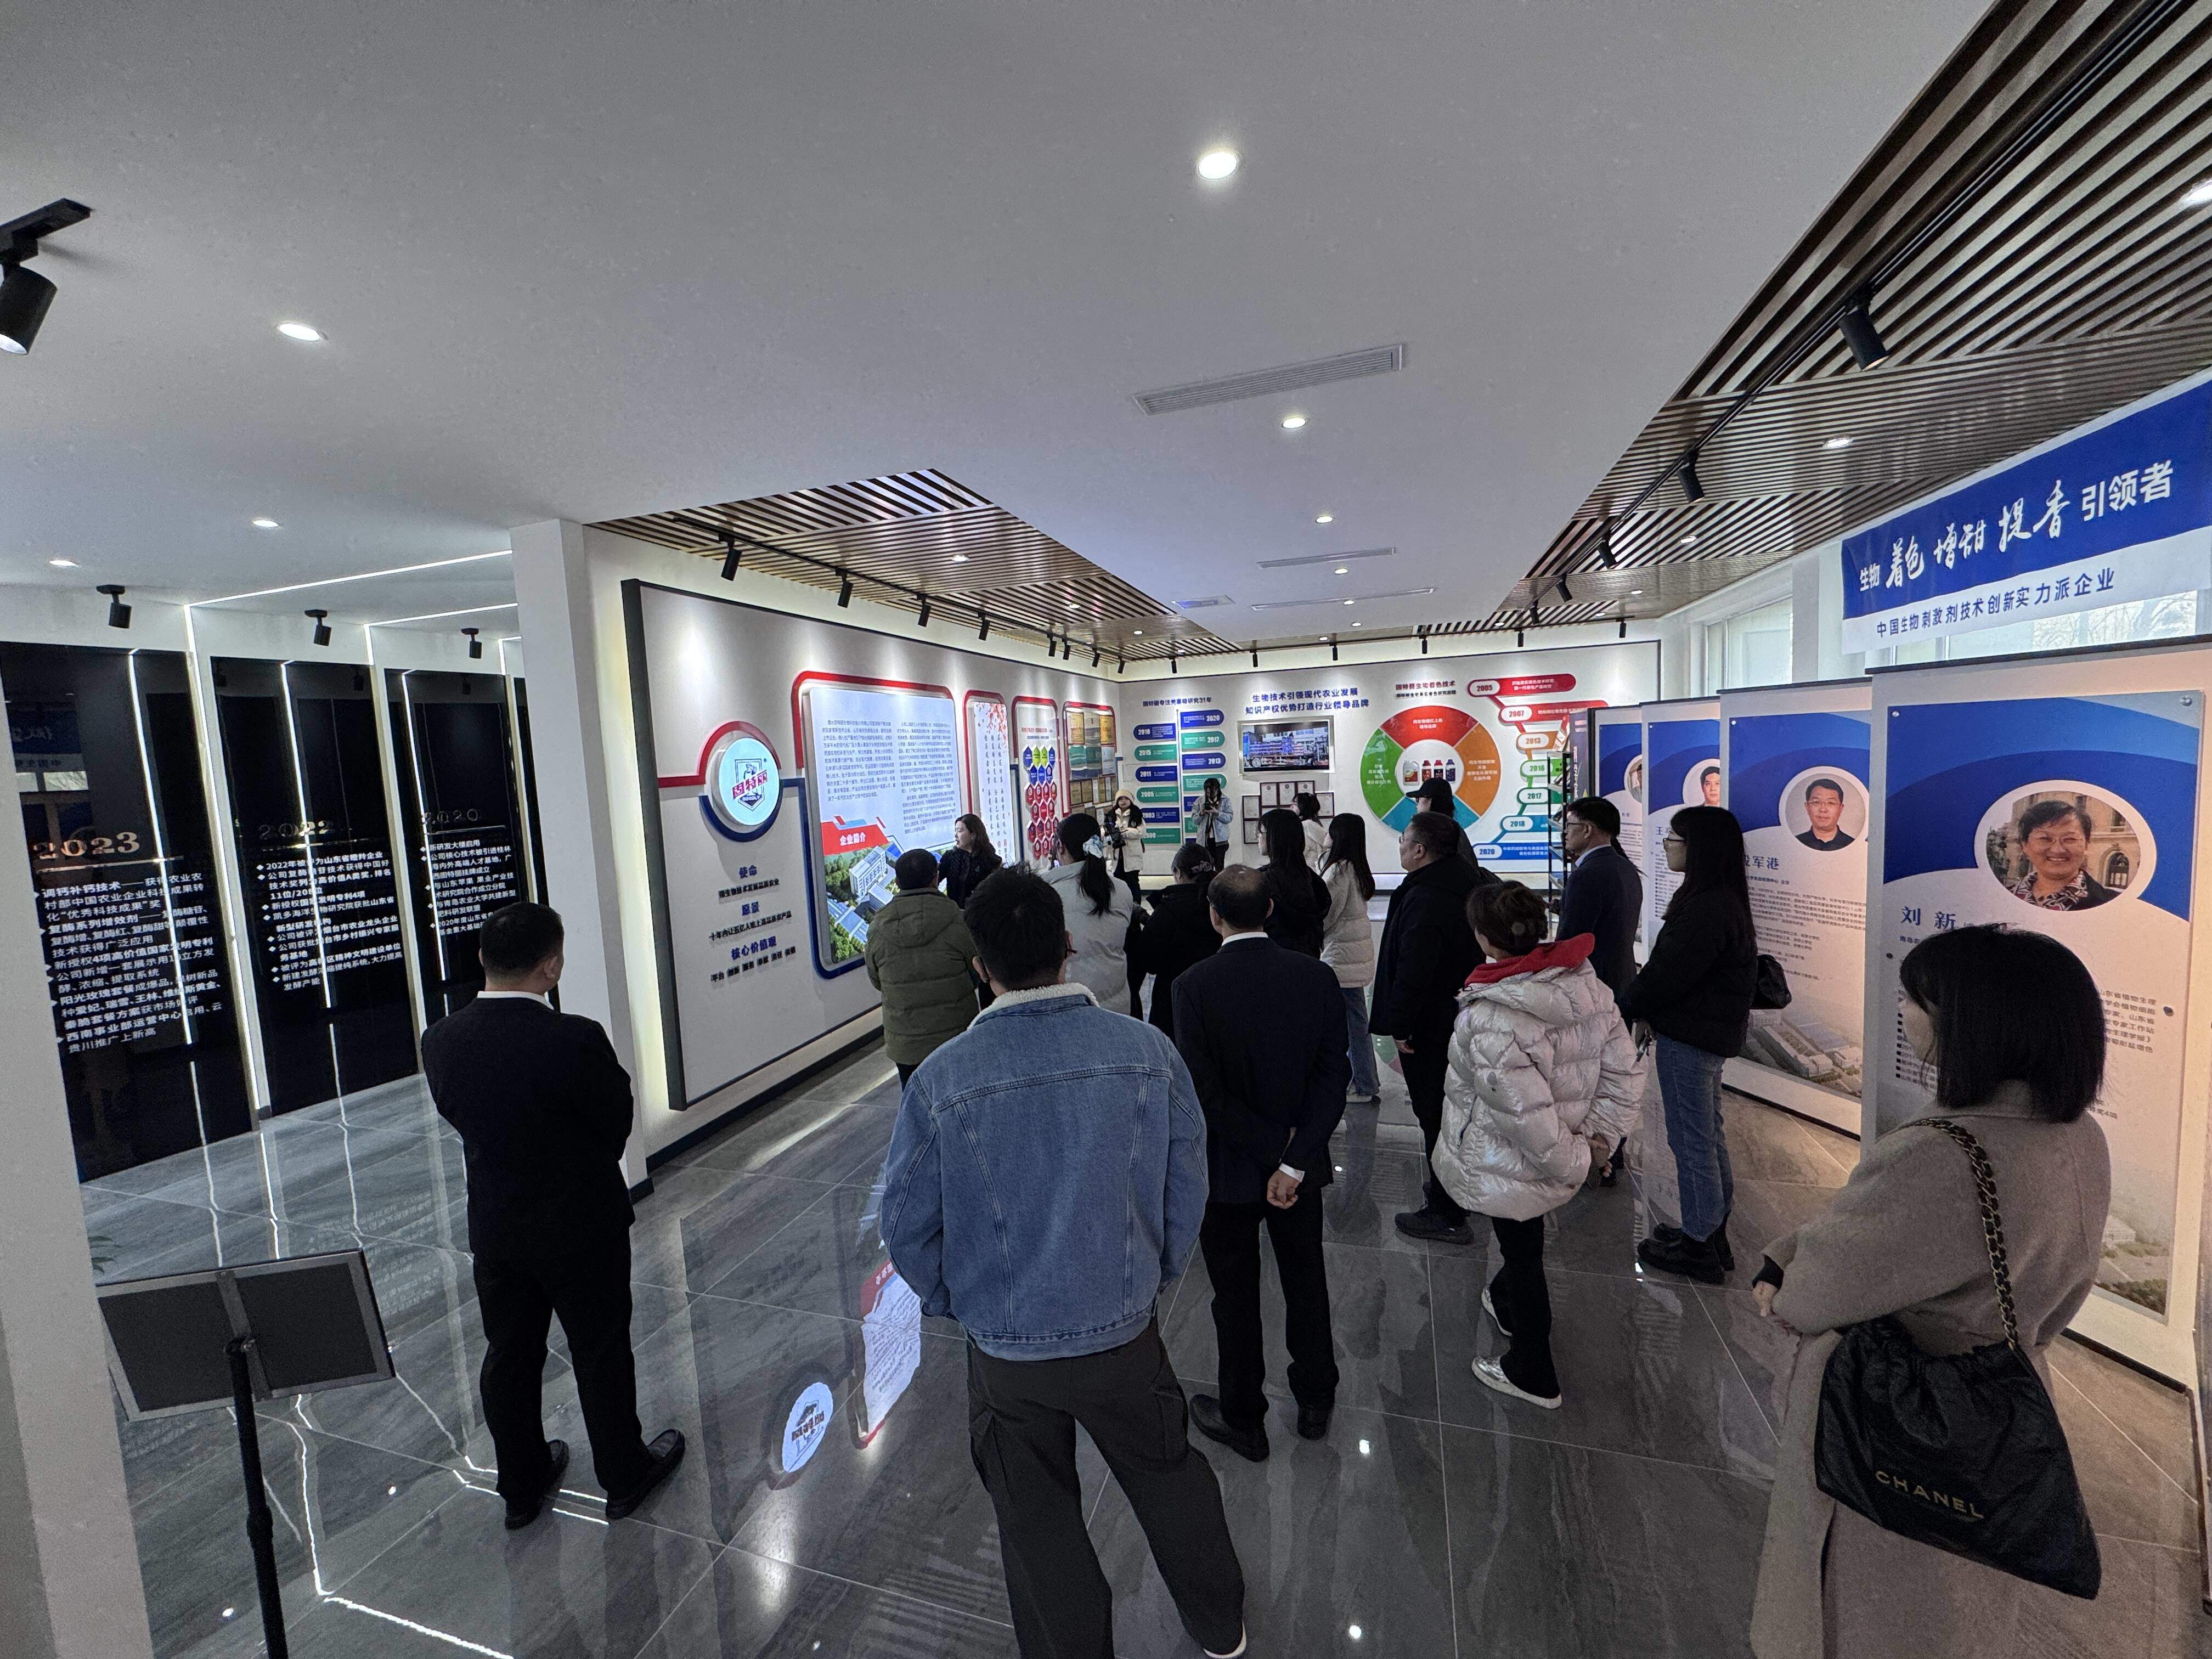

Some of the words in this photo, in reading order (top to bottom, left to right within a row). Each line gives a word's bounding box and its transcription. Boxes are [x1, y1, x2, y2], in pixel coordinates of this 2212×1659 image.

[1860, 563, 1881, 591] 生物
[1886, 535, 1925, 589] 着色
[1933, 519, 1985, 569] 增甜
[1998, 480, 2070, 553] 提香
[2081, 460, 2174, 522] 引领者
[1252, 687, 1358, 703] 生物技术引领现代农业发展
[1245, 699, 1369, 715] 知识产权优势打造行业领导品牌
[732, 769, 768, 800] 固特丽
[33, 832, 140, 859] 2023
[430, 839, 480, 851] 新研发大楼启用
[839, 832, 866, 847] 企业简介
[431, 846, 511, 861] 公司核心技术被引进桂林
[739, 865, 757, 878] 使命
[435, 882, 506, 898] 术研究院合作成立分院
[437, 890, 516, 908] 与青岛农业大学共建新型
[742, 901, 760, 916] 愿景
[1900, 906, 1921, 926] 刘
[1934, 911, 1956, 931] 新
[53, 936, 154, 958] 技术获得广泛应用
[280, 950, 308, 961] 务基地
[731, 935, 777, 960] 核心价值观
[58, 969, 160, 994] 酵、浓缩、提取系统
[284, 978, 320, 991] 发酵产能
[69, 1028, 156, 1053] 贵川推广上新高
[1875, 1470, 1984, 1519] CHANEL
